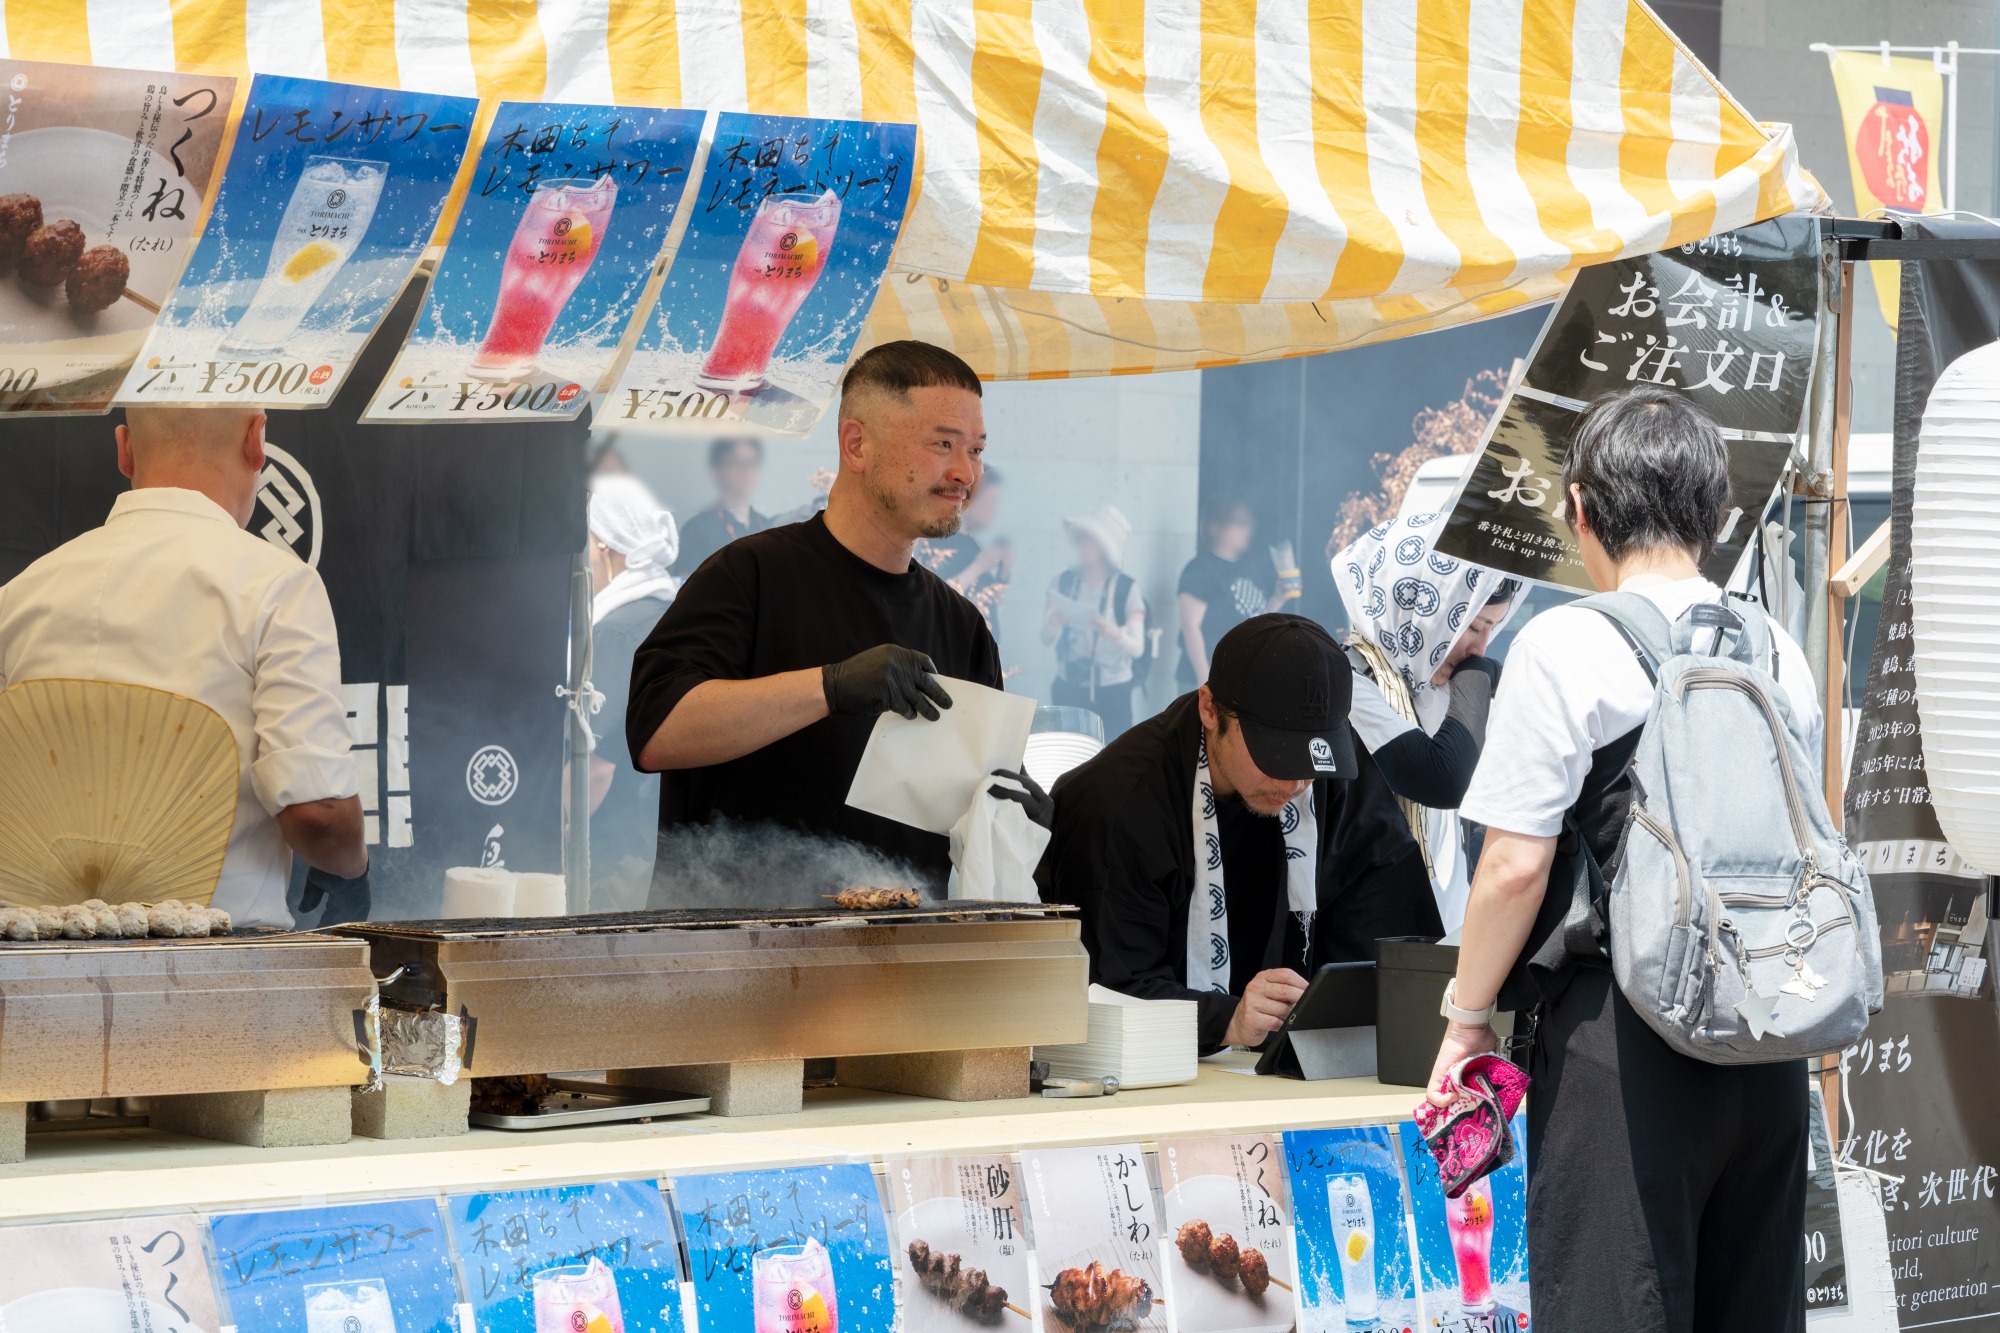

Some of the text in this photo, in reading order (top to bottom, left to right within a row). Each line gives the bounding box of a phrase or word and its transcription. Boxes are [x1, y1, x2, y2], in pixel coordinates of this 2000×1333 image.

[251, 108, 463, 144] レモンサワー
[142, 88, 217, 222] つくね
[481, 159, 684, 197] レモンサワー
[310, 210, 350, 220] TORIMACHI
[309, 223, 348, 239] とりまち
[538, 238, 577, 246] TORIMACHI
[538, 250, 576, 265] とりまち
[764, 252, 804, 260] TORIMACHI
[1699, 234, 1743, 257] とりまち
[765, 264, 802, 279] とりまち
[1579, 329, 1786, 395] ご注文口
[196, 361, 309, 395] ¥500
[449, 382, 557, 411] ¥500
[621, 388, 731, 420] ¥500
[1490, 538, 1516, 552] Pick
[1520, 547, 1536, 558] up
[1540, 551, 1564, 563] with
[1867, 720, 1921, 743] 2023年の
[1860, 754, 1926, 777] 2025年には
[1246, 1142, 1281, 1229] つくね
[984, 1163, 1017, 1241] 砂肝
[1114, 1153, 1150, 1244] かしわ
[1346, 1217, 1366, 1228] とりまち
[1464, 1215, 1484, 1226] とりまち
[1927, 1225, 1979, 1247] culture
[230, 1223, 434, 1284] レモンサワー
[140, 1230, 191, 1333] つく
[480, 1239, 665, 1300] レモンサワー
[1816, 1285, 1844, 1302] とりまち
[1911, 1278, 1987, 1311] generation
[778, 1311, 815, 1322] TORIMACHI
